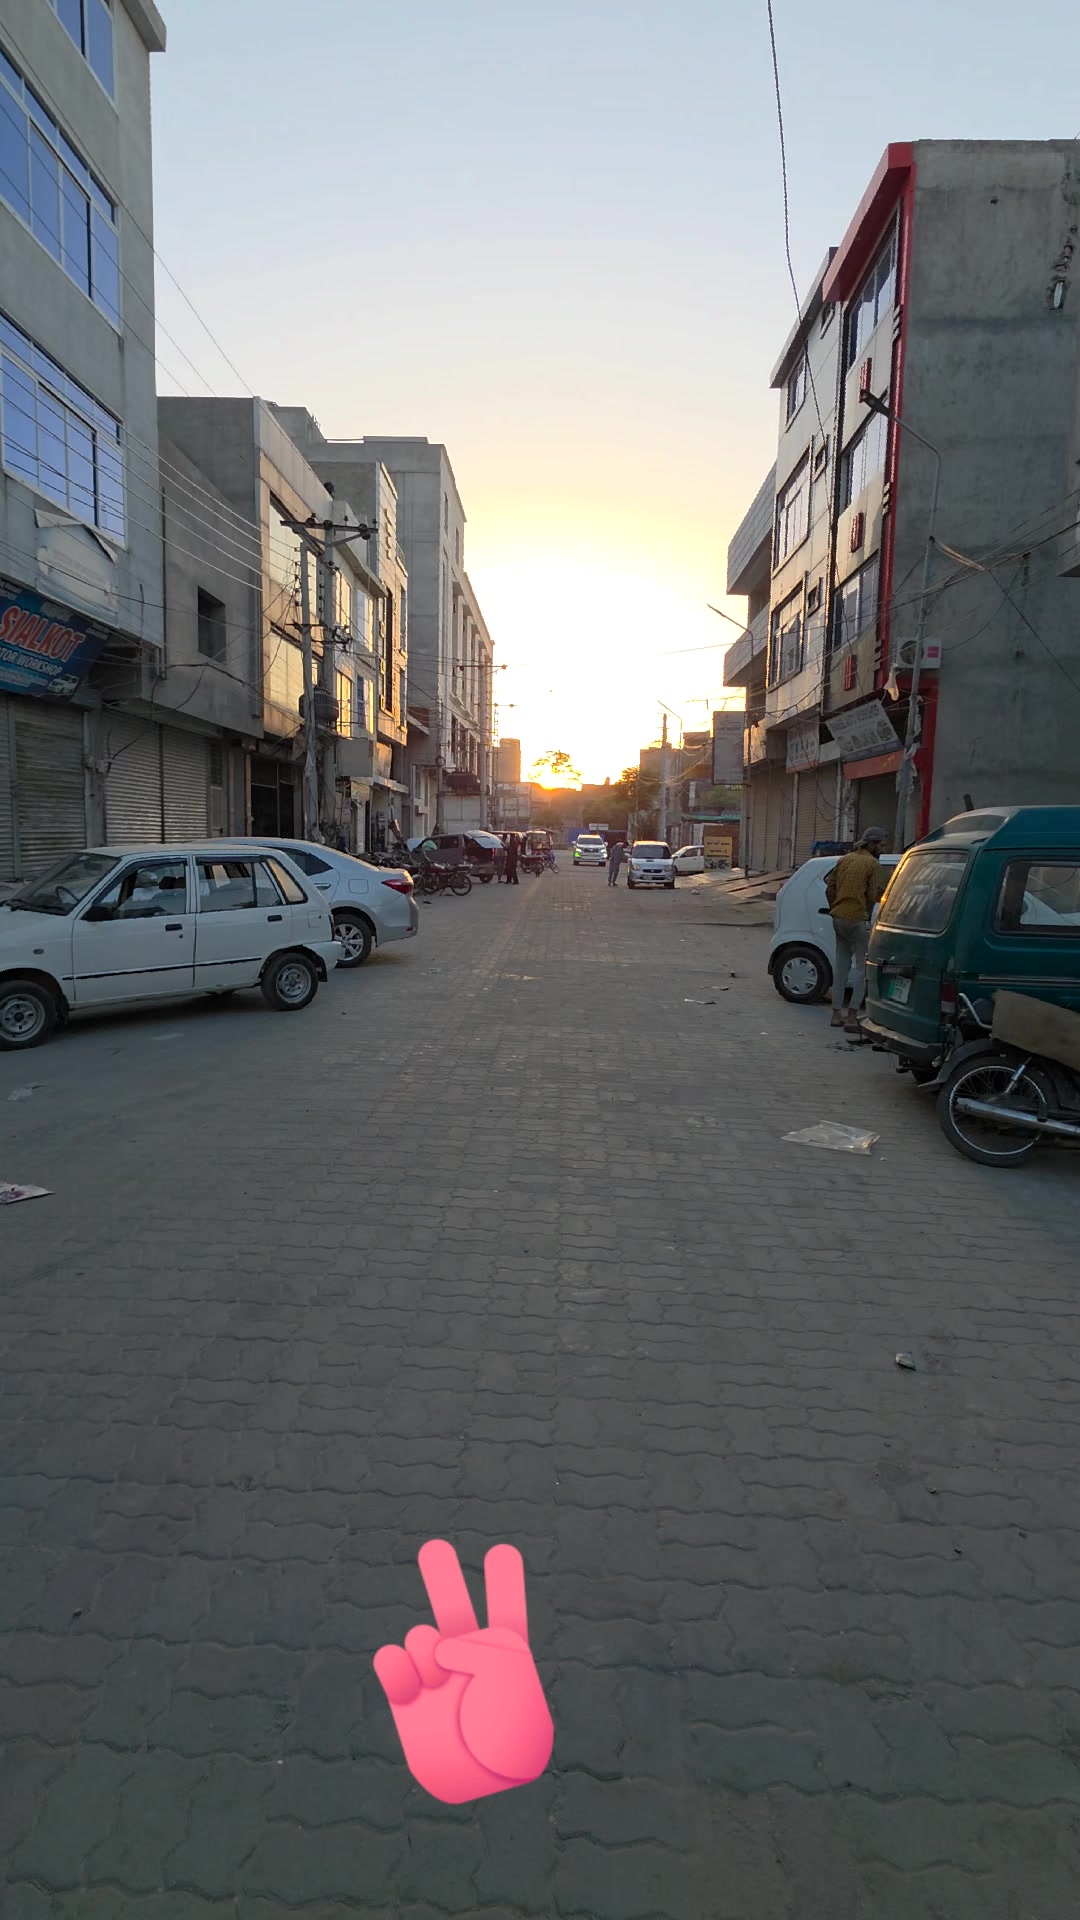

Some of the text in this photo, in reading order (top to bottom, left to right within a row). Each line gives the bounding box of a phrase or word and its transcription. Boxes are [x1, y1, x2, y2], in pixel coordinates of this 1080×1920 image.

[0, 605, 87, 663] SIALKOT
[0, 646, 63, 676] TOR WORKSHOP
